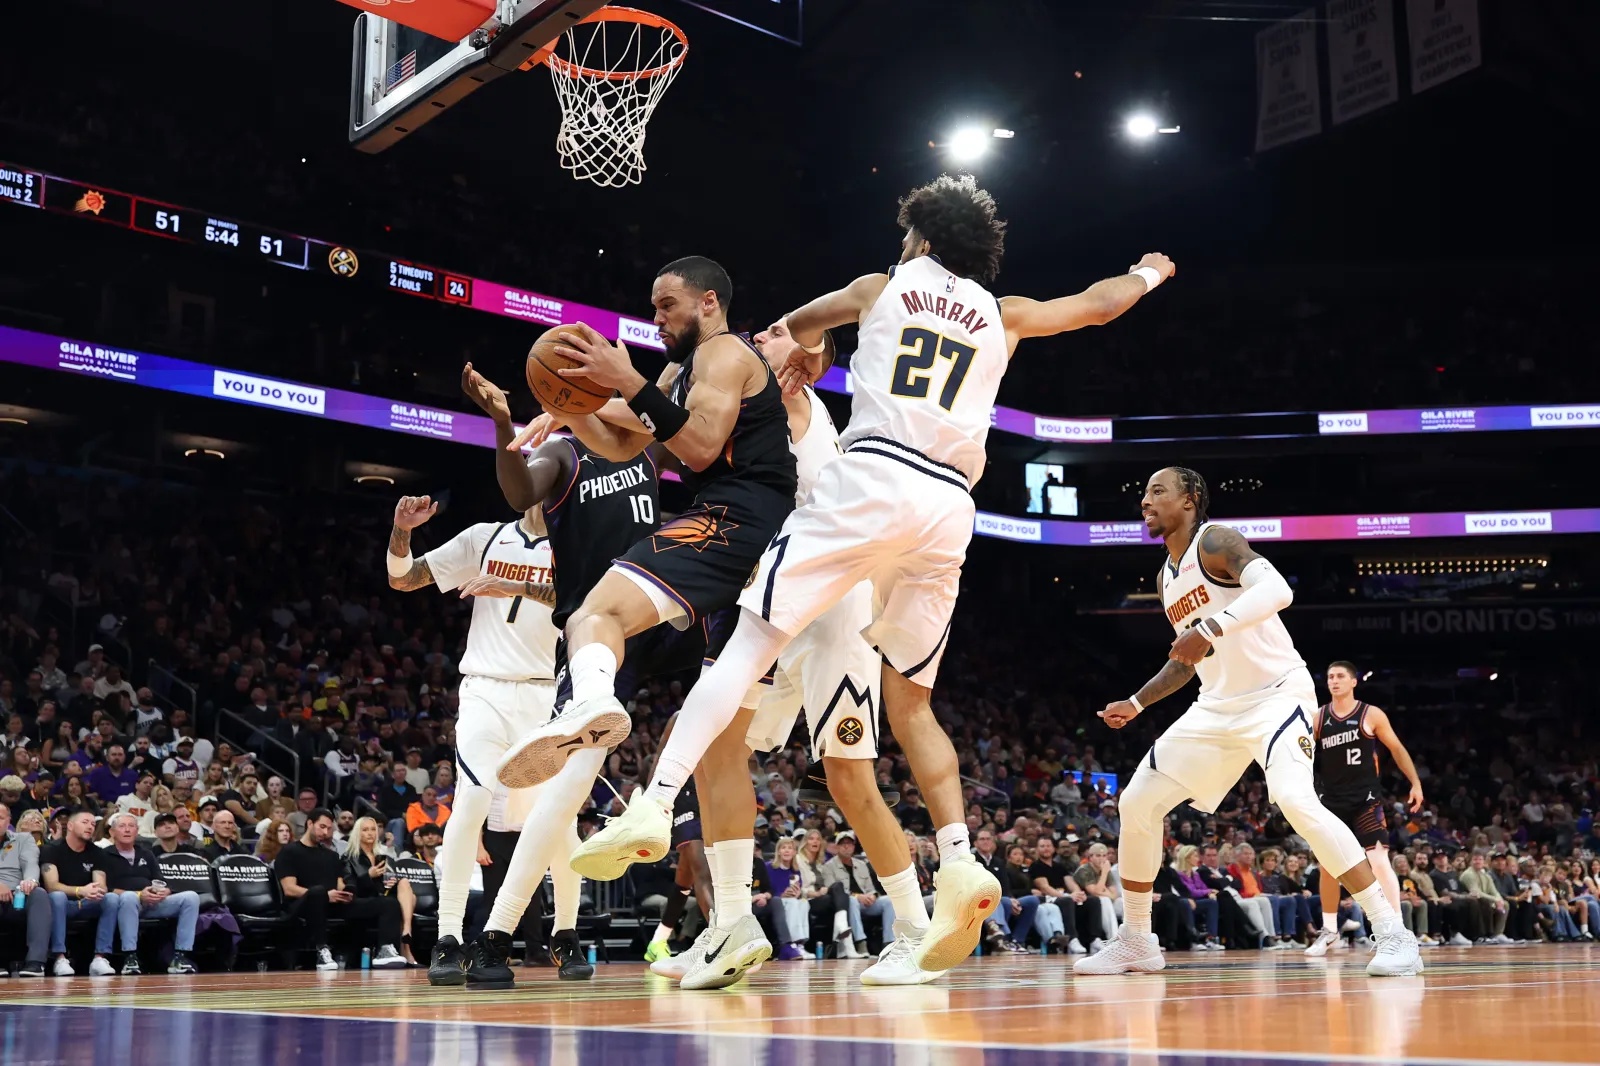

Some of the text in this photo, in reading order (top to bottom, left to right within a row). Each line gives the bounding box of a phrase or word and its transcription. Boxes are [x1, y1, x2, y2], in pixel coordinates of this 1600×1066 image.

[25, 174, 33, 187] 5
[24, 188, 32, 202] 2
[155, 210, 180, 233] 51
[205, 226, 239, 247] 5:44
[259, 235, 283, 257] 51
[390, 261, 433, 282] 5 TIMEOUTS
[390, 274, 421, 292] 2 FOULS
[450, 281, 464, 297] 24
[504, 290, 530, 304] GILA
[531, 296, 562, 312] RIVER
[901, 290, 988, 335] MURRAY
[625, 325, 650, 338] YOU
[60, 341, 137, 365] GILA RIVER
[890, 325, 979, 413] 27
[223, 379, 317, 405] YOU DO YOU
[391, 404, 453, 424] GILA RIVER
[1337, 419, 1362, 427] YOU
[1421, 410, 1475, 419] GILA RIVER
[1567, 412, 1584, 420] DO
[1040, 424, 1108, 435] YOU DO YOU
[579, 463, 649, 504] PHOENIX
[628, 494, 654, 525] 10
[980, 520, 1036, 534] YOU DO YOU
[1089, 524, 1142, 533] GILA RIVER
[1357, 516, 1410, 525] GILA RIVER
[1472, 519, 1496, 527] YOU
[1521, 518, 1546, 526] YOU
[487, 560, 553, 583] NUGGETS
[1399, 608, 1557, 634] HORNITOS
[1321, 728, 1360, 750] PHOENIX
[1346, 748, 1361, 765] 12
[179, 864, 209, 872] RIVER
[219, 865, 240, 873] GILA
